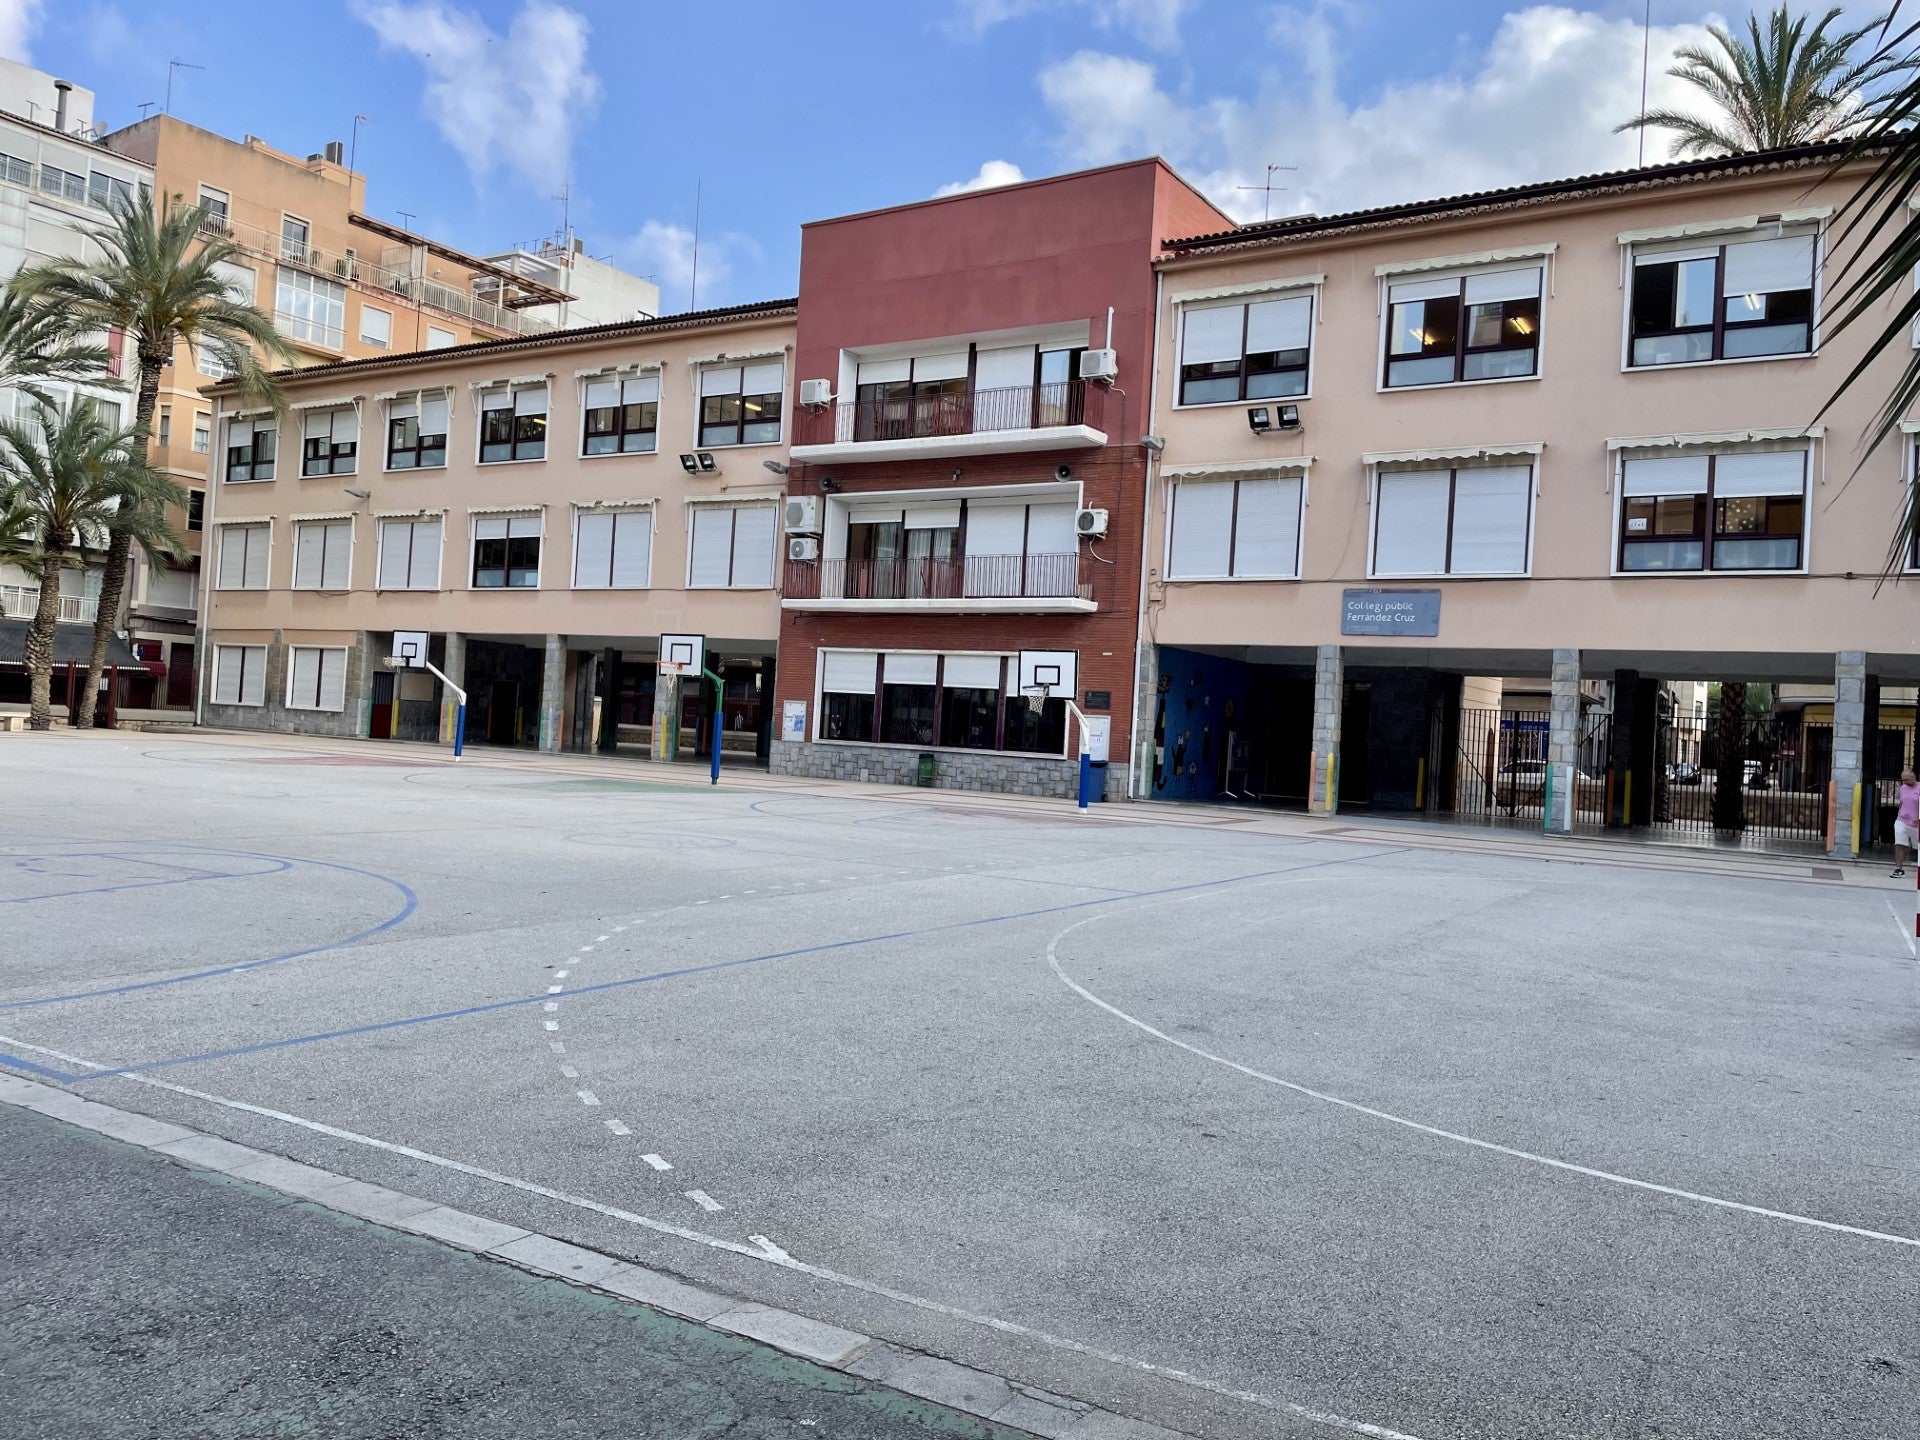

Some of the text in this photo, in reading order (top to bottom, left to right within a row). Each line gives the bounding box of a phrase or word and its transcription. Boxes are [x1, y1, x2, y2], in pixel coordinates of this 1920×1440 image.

[1385, 601, 1413, 611] públic
[1347, 612, 1416, 622] Ferrández Cruz
